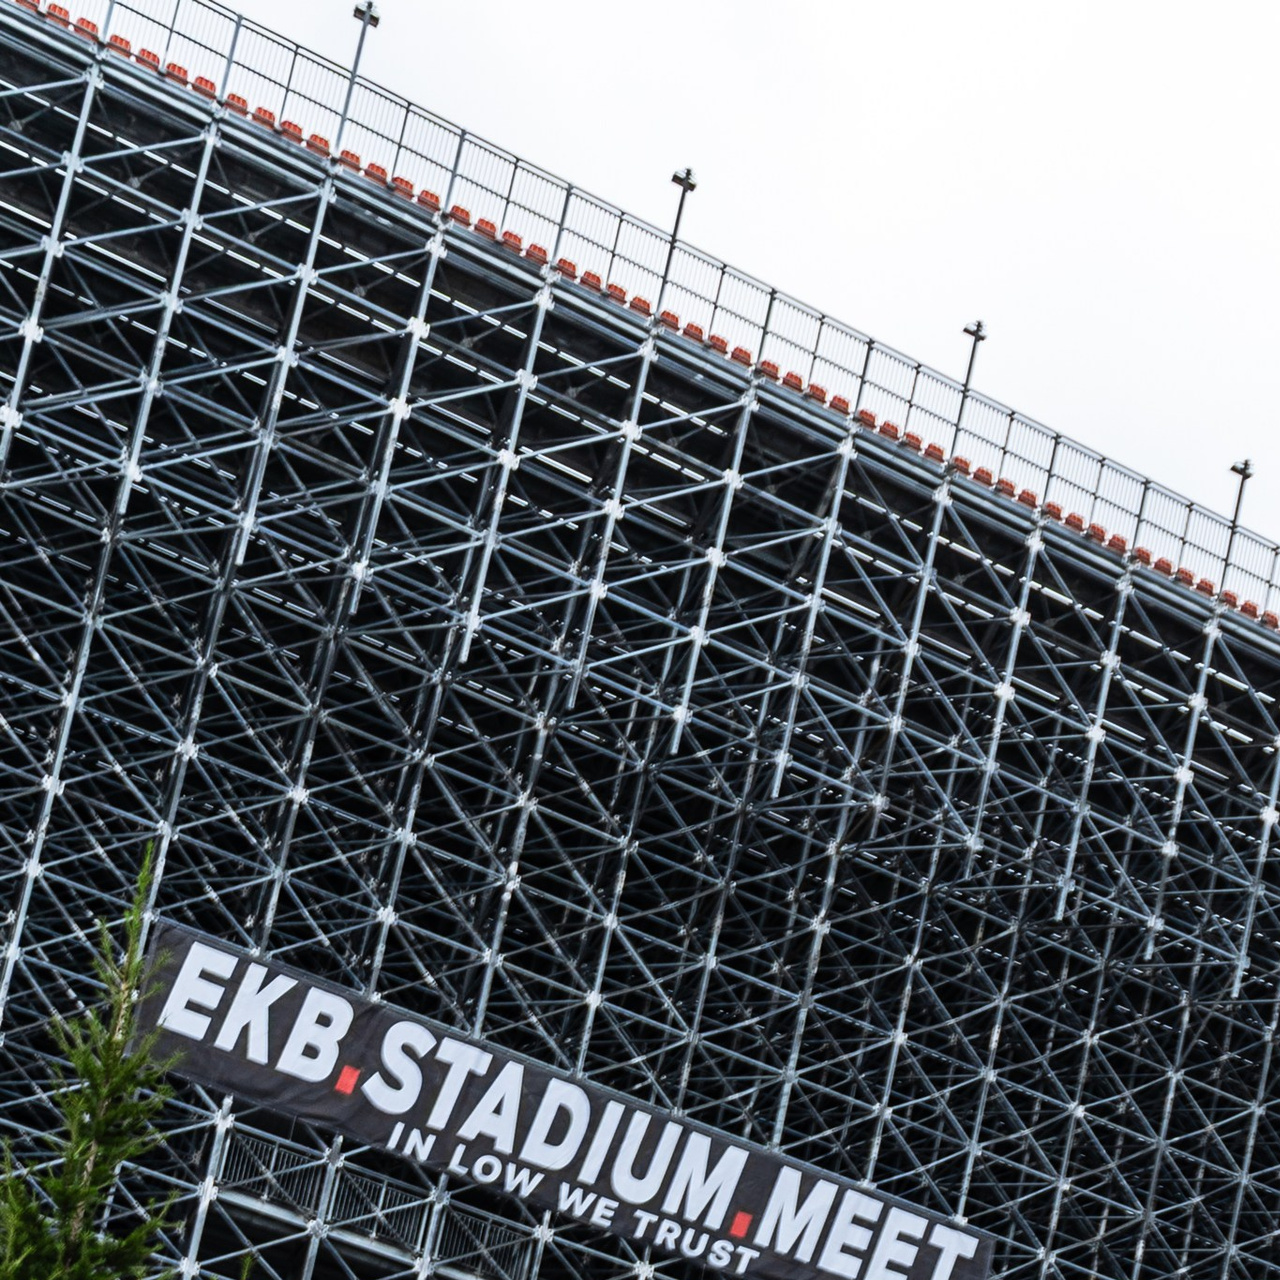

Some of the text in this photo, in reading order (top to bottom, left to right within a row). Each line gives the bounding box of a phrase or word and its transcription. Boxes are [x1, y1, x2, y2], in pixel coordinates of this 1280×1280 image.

[386, 1121, 761, 1274] IN LOW WE TRUST
